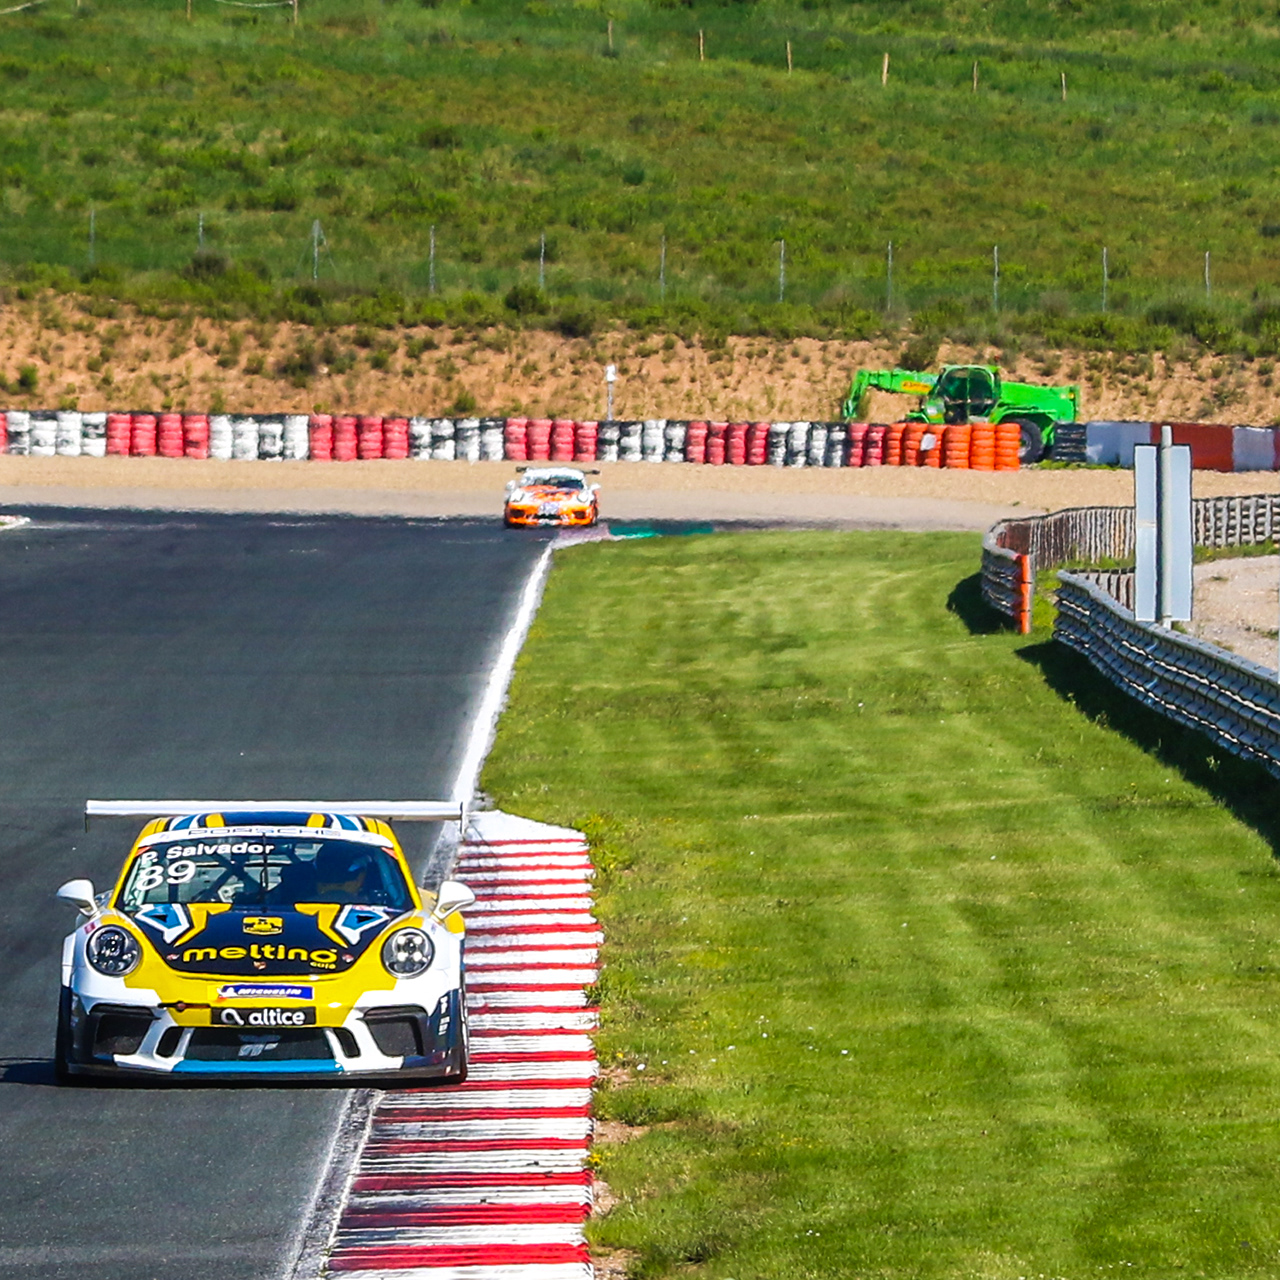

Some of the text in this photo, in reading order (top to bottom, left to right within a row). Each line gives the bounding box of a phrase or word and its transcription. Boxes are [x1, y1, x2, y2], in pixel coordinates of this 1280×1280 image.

[141, 842, 275, 865] P. Salvador
[136, 860, 197, 891] 89
[183, 944, 338, 963] melting
[248, 1008, 306, 1026] altice
